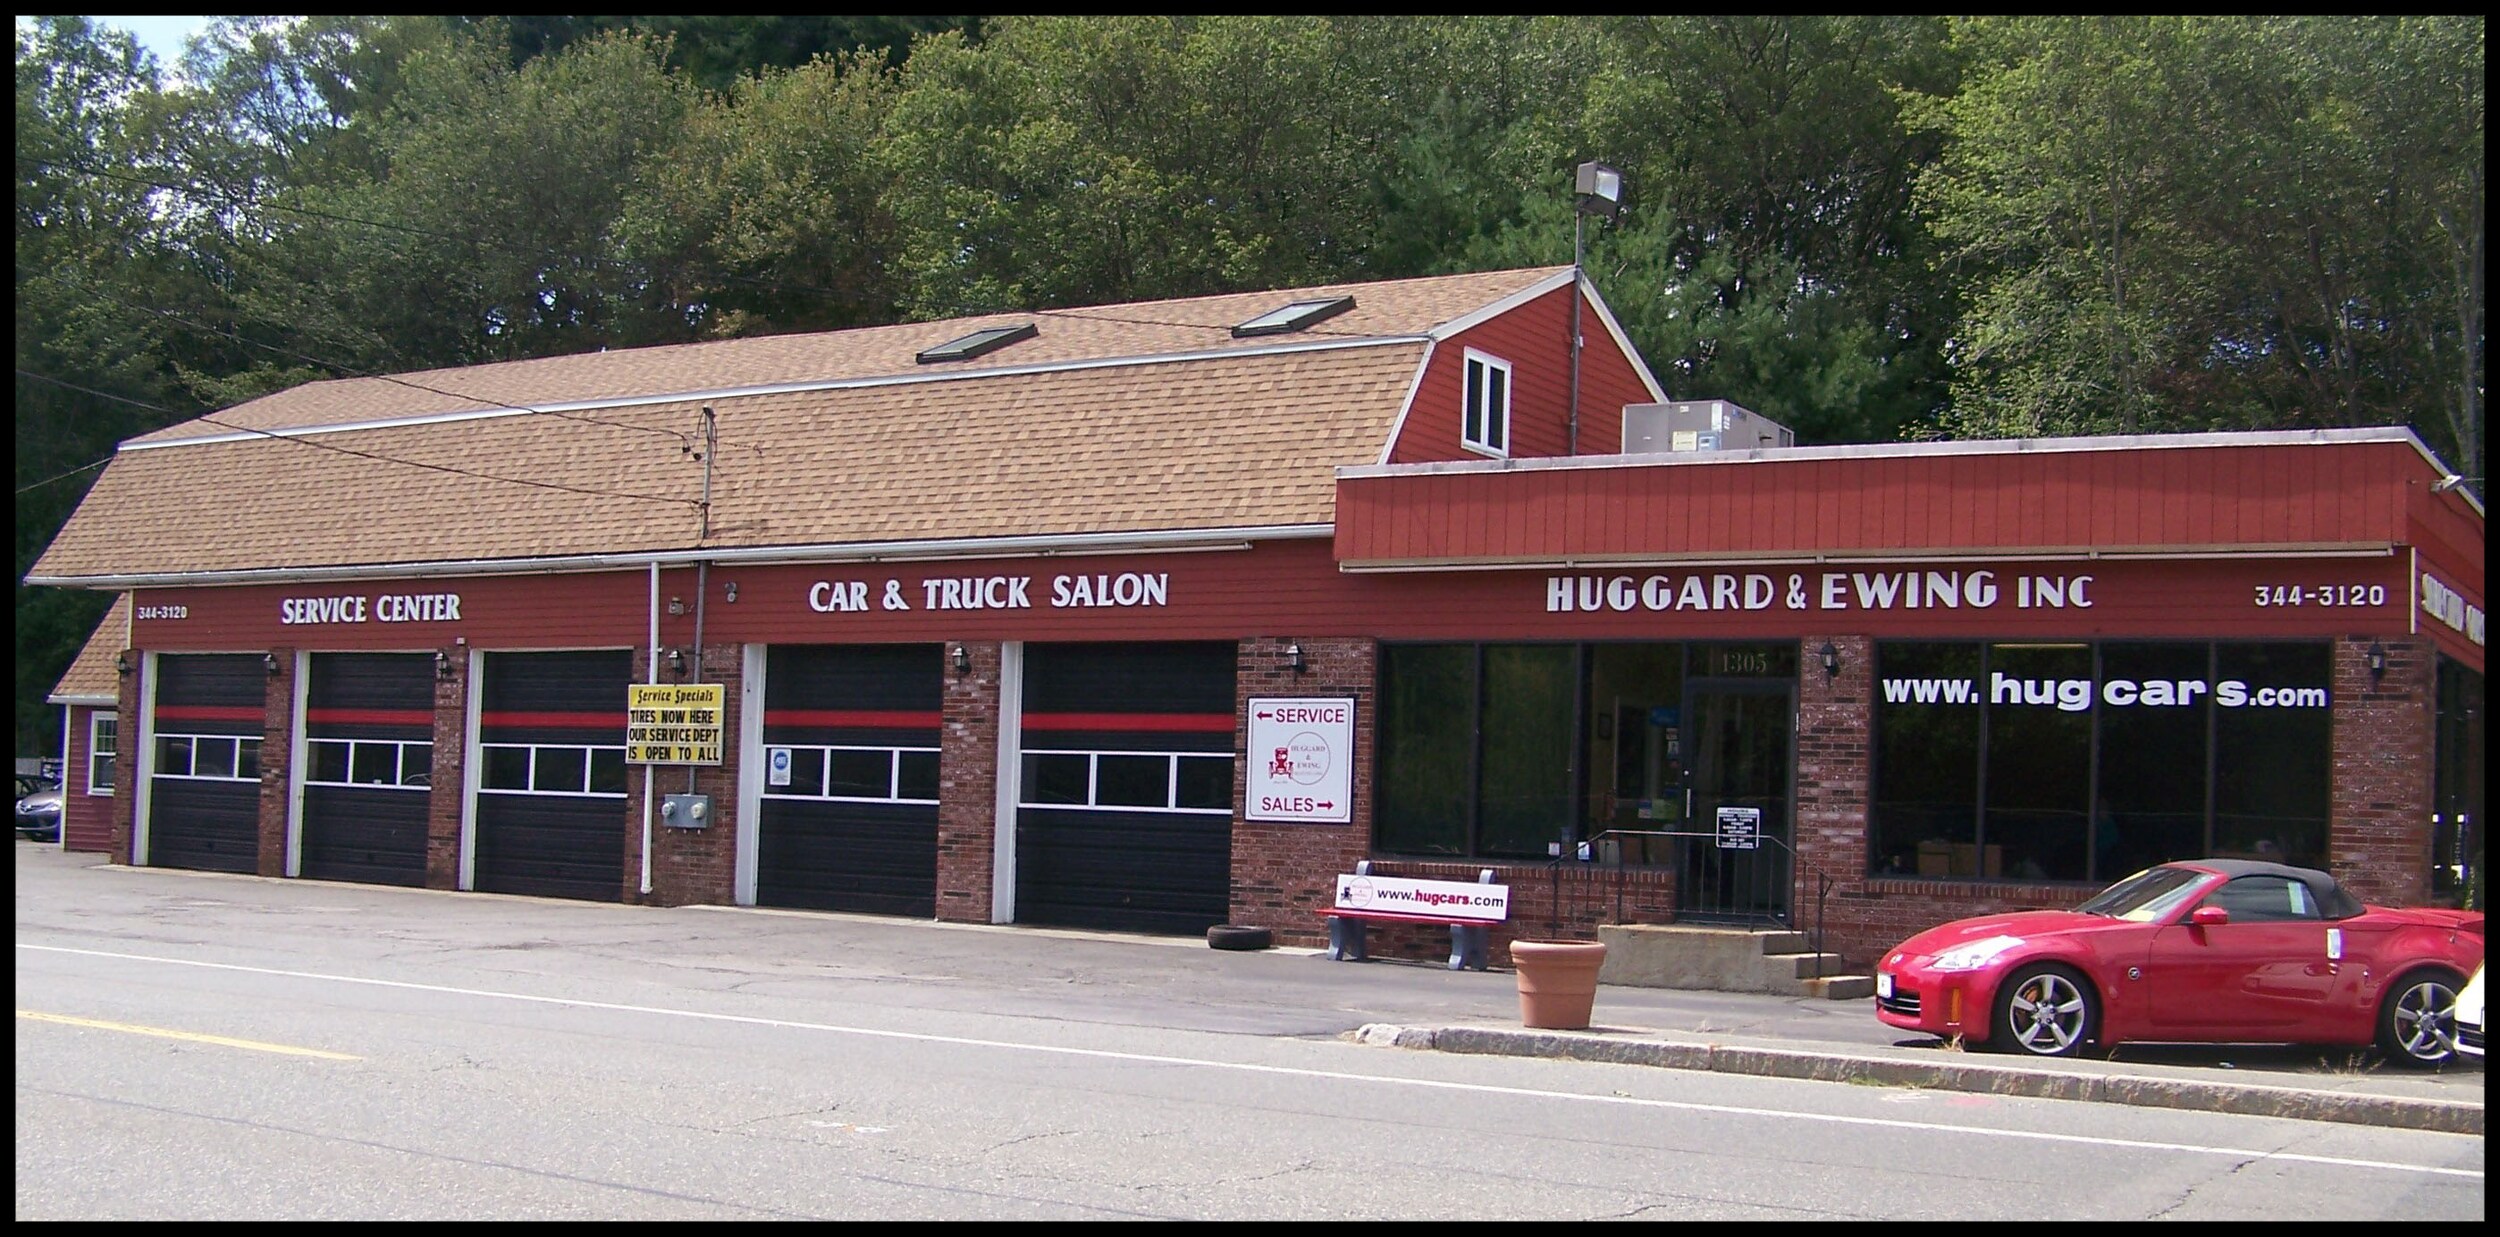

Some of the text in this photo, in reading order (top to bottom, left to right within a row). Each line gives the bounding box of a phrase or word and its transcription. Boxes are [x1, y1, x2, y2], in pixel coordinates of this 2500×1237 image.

[809, 573, 1169, 611] CAR & TRUCK SALON
[1546, 571, 2094, 611] HUGGARD & EWING INC
[2254, 584, 2385, 606] 344-3120
[138, 606, 188, 619] 344-3120
[282, 594, 461, 624] SERVICE CENTER
[1722, 652, 1767, 673] 1305
[637, 690, 713, 704] Service Specials
[630, 710, 714, 724] TIRES NOW HERE
[1275, 708, 1345, 723] SERVICE
[629, 728, 719, 743] OUR SERVICE DEPT
[628, 746, 719, 761] IS OPEN TO ALL
[1261, 797, 1314, 812] SALES
[1377, 889, 1504, 908] www.hugcars.com
